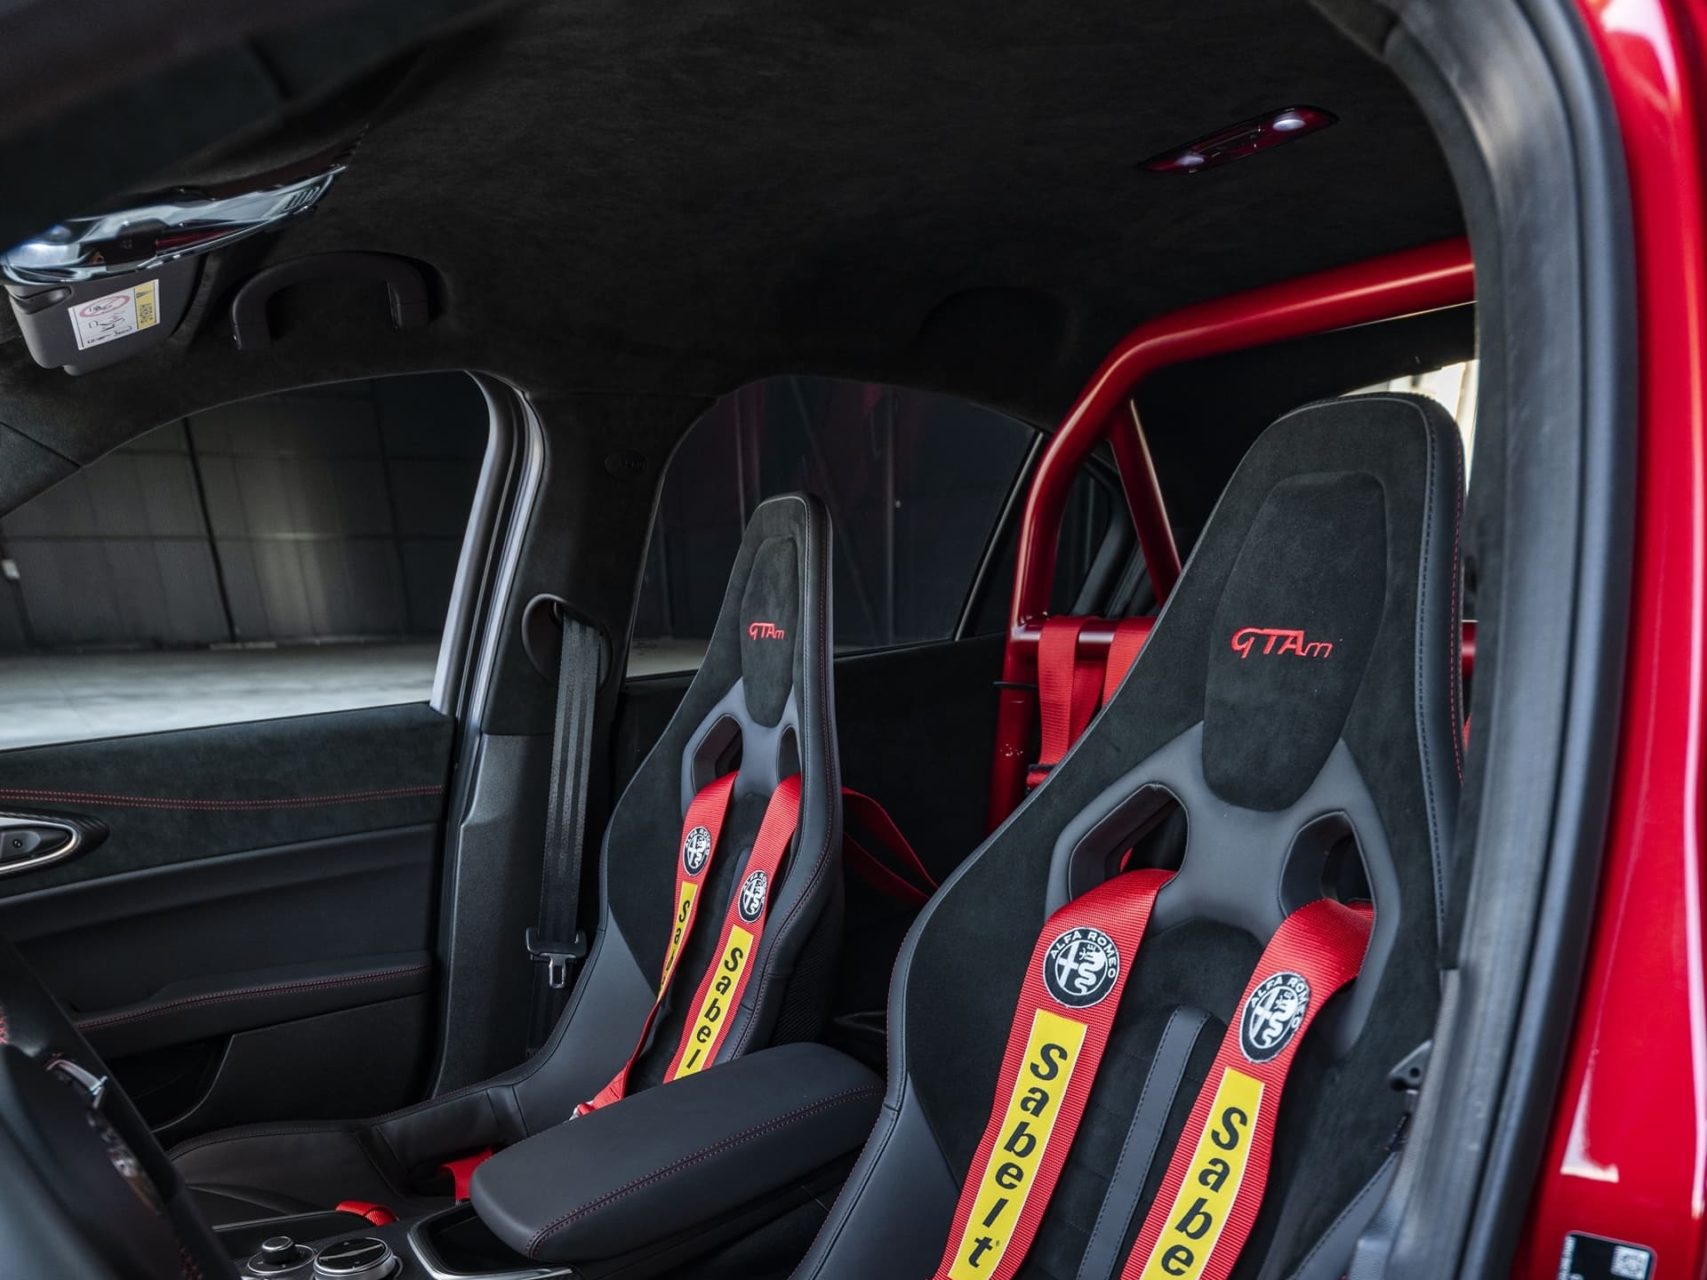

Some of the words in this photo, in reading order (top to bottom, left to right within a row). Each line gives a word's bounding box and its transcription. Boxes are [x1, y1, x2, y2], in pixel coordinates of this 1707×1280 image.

[1231, 627, 1333, 659] GTAm
[1050, 930, 1082, 960] ALFA
[1087, 931, 1117, 979] ROMEO
[1251, 976, 1284, 1008] ALFA
[968, 1042, 1068, 1268] Sabelt
